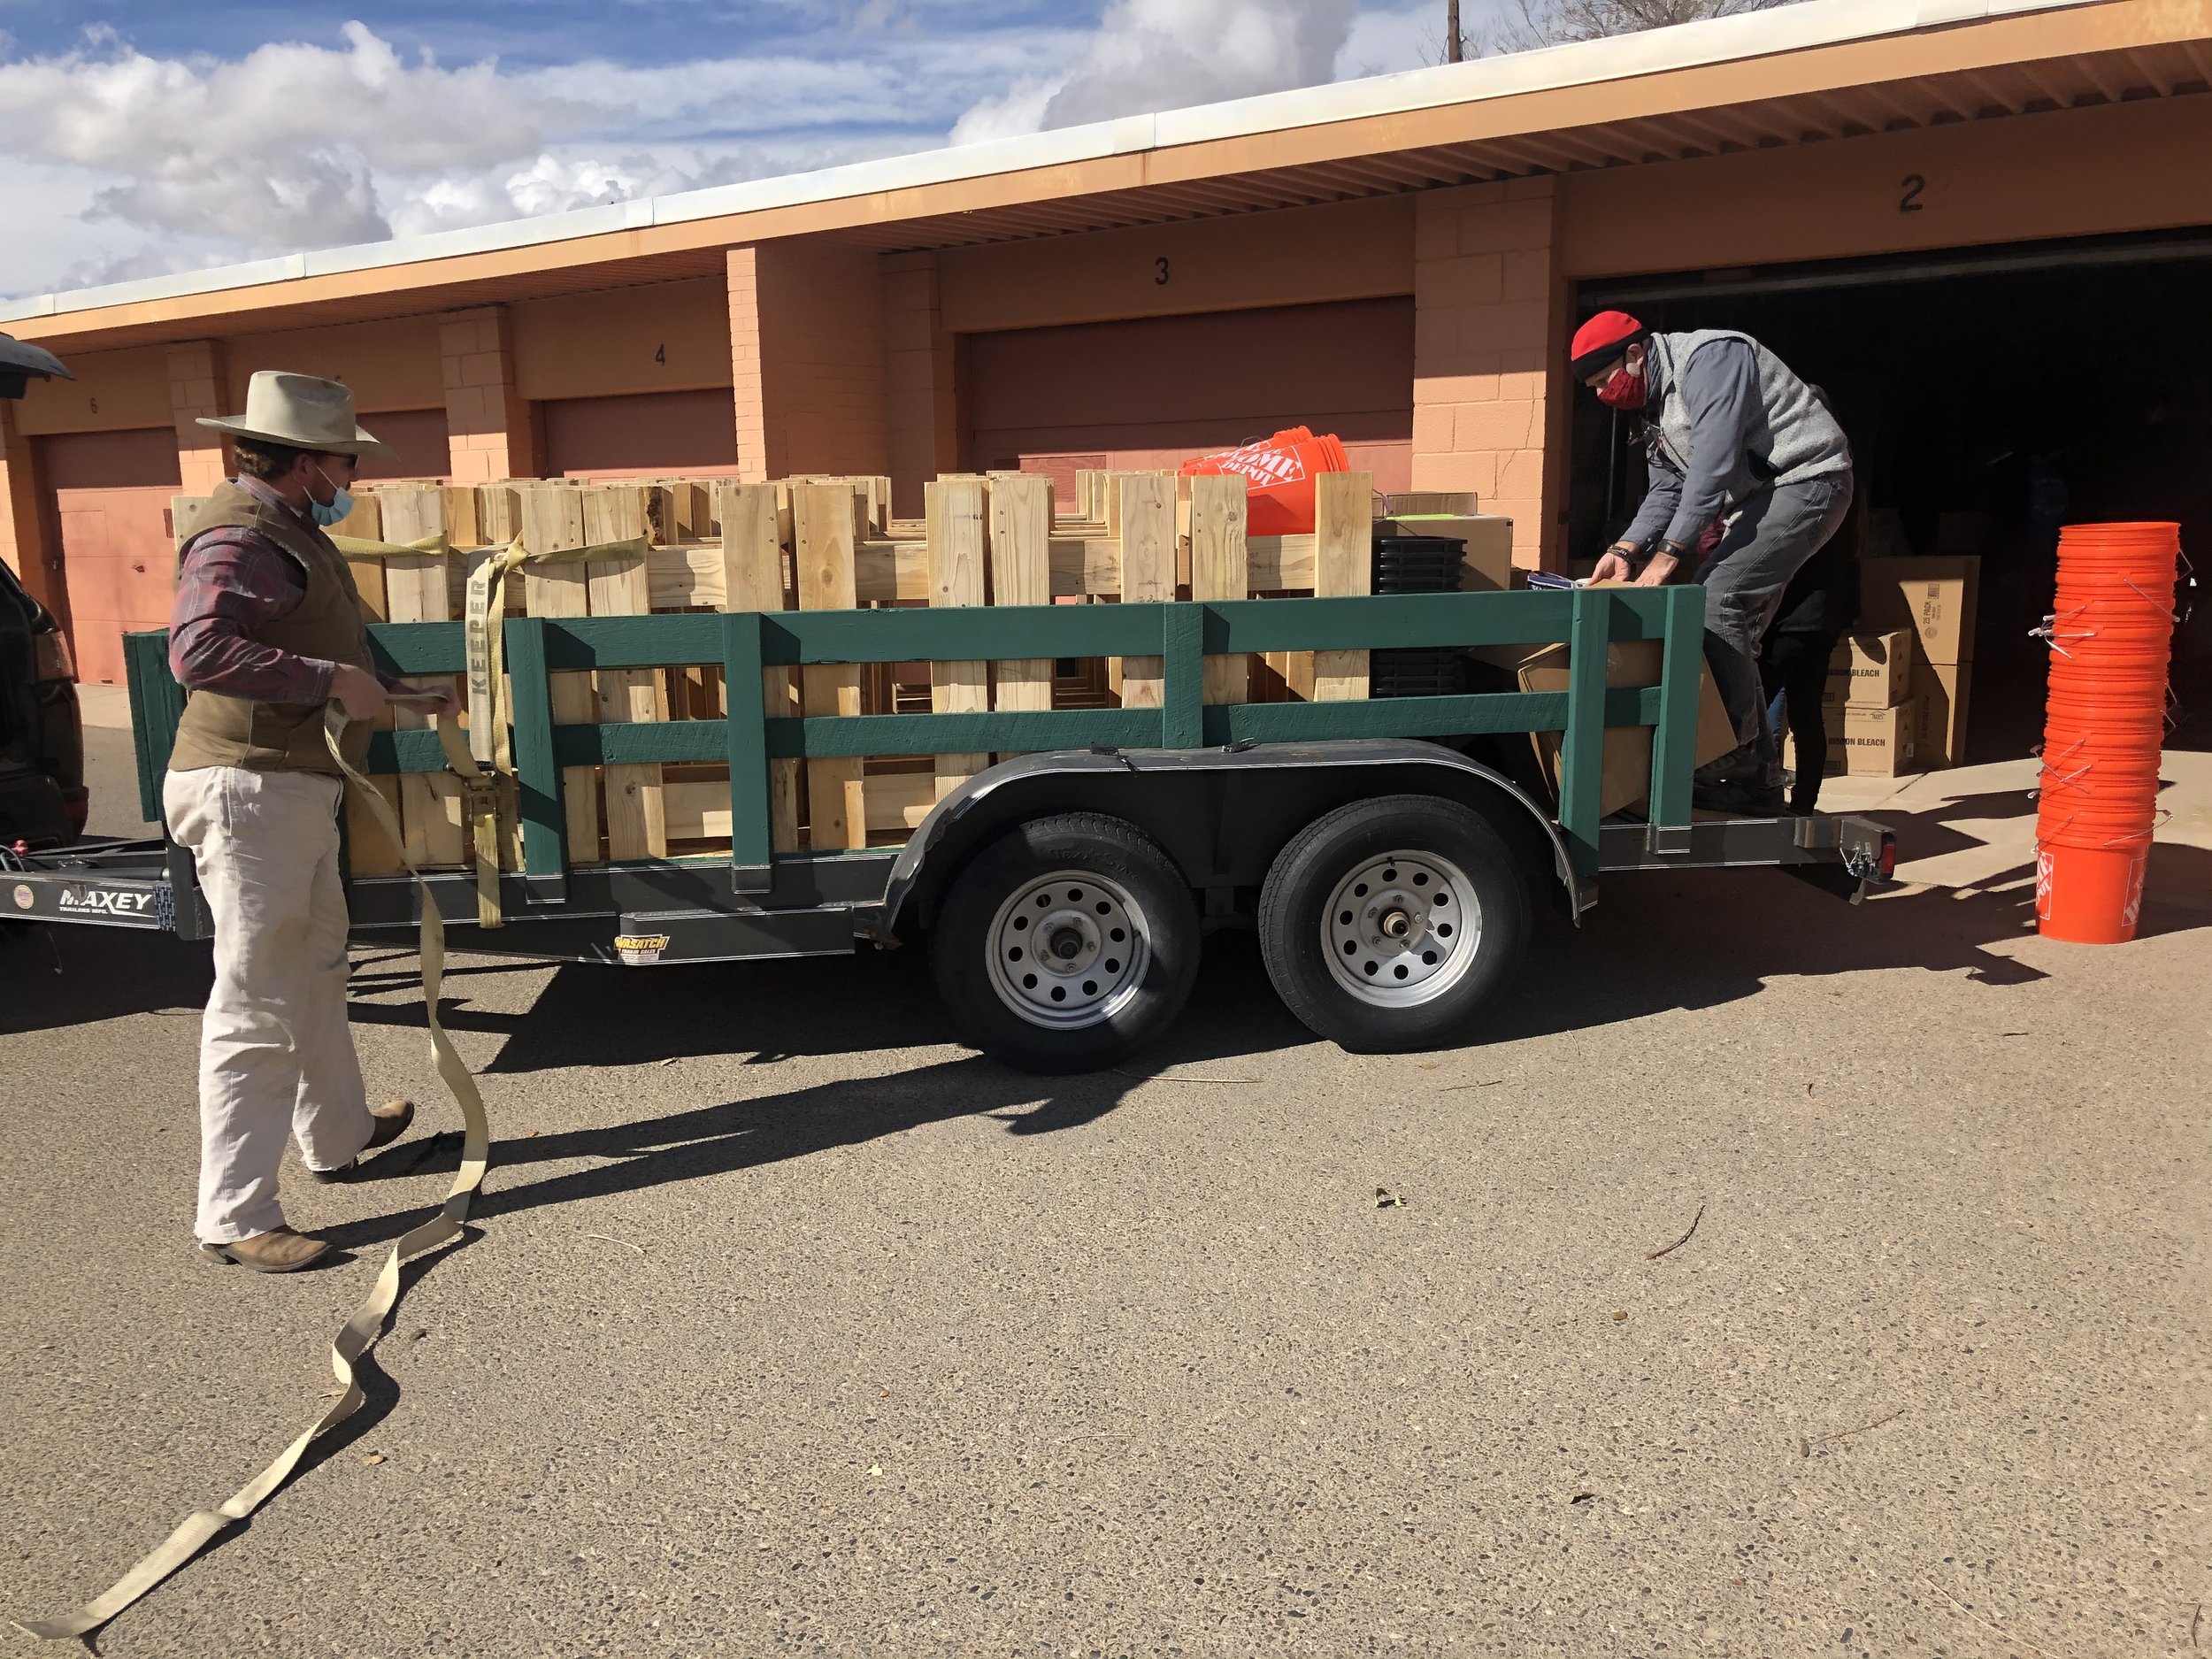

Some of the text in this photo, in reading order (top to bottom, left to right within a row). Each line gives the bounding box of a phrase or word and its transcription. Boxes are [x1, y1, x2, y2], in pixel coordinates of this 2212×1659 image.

[1900, 174, 1925, 212] 2
[1155, 257, 1169, 285] 3
[656, 343, 665, 367] 4
[89, 397, 97, 414] 6
[1221, 461, 1274, 486] DEPOT
[1233, 452, 1301, 481] OME
[1923, 601, 1932, 616] PACK
[471, 580, 488, 695] KEEPER
[1828, 737, 1886, 747] RIBBON BLEACH
[60, 889, 153, 911] MAXEY
[616, 938, 666, 949] WASATCH
